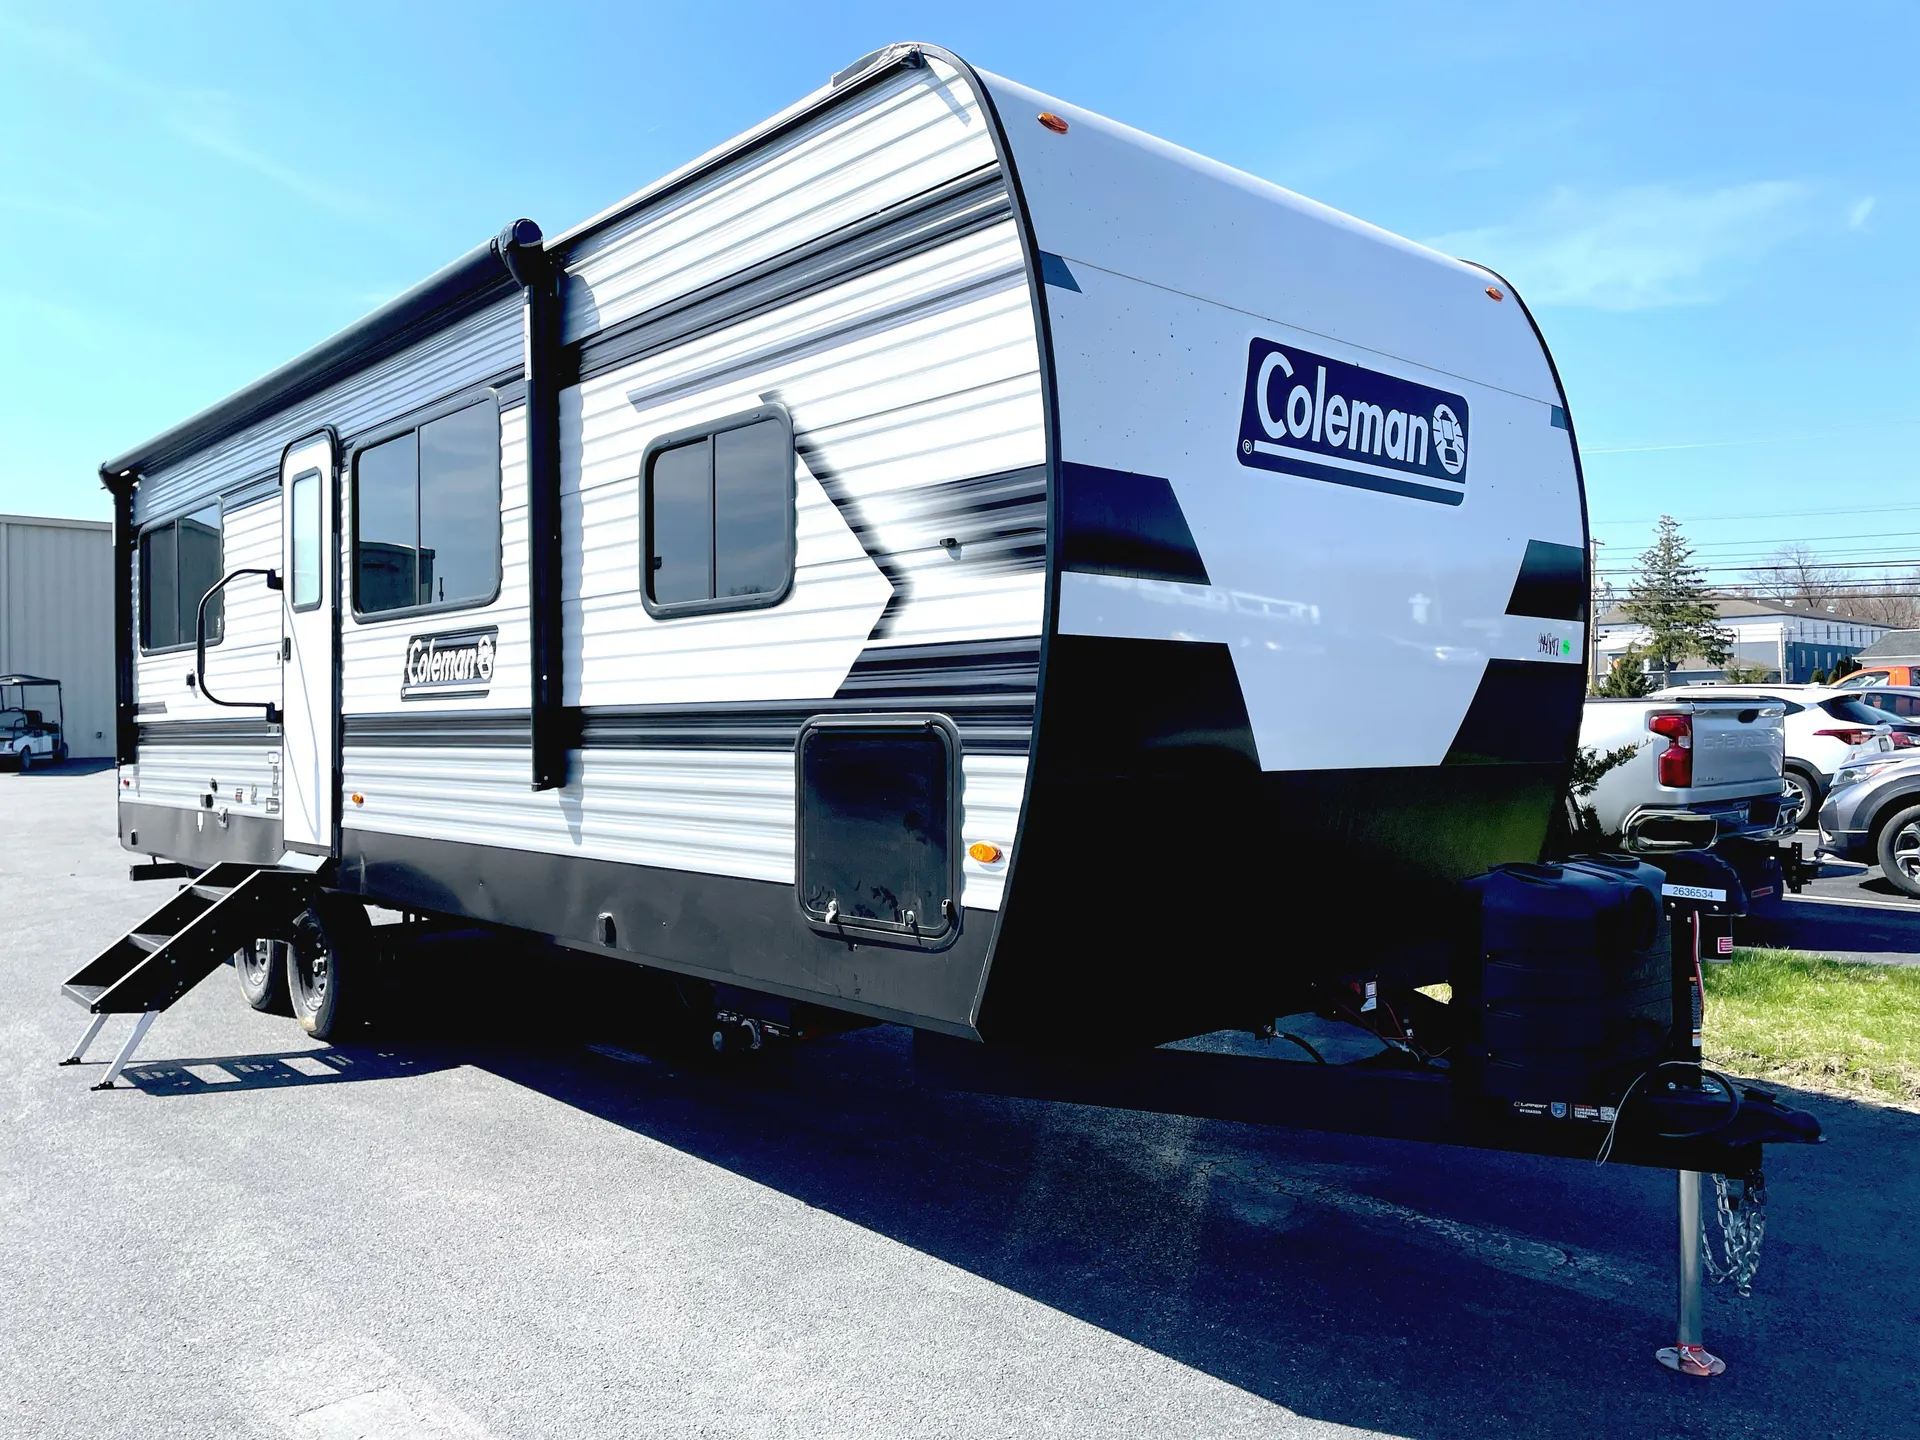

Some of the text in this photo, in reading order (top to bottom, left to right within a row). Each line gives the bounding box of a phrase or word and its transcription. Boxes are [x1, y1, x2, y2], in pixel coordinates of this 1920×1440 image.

[1257, 351, 1429, 466] Coleman
[407, 637, 477, 687] Coleman
[1672, 886, 1714, 899] 2636534
